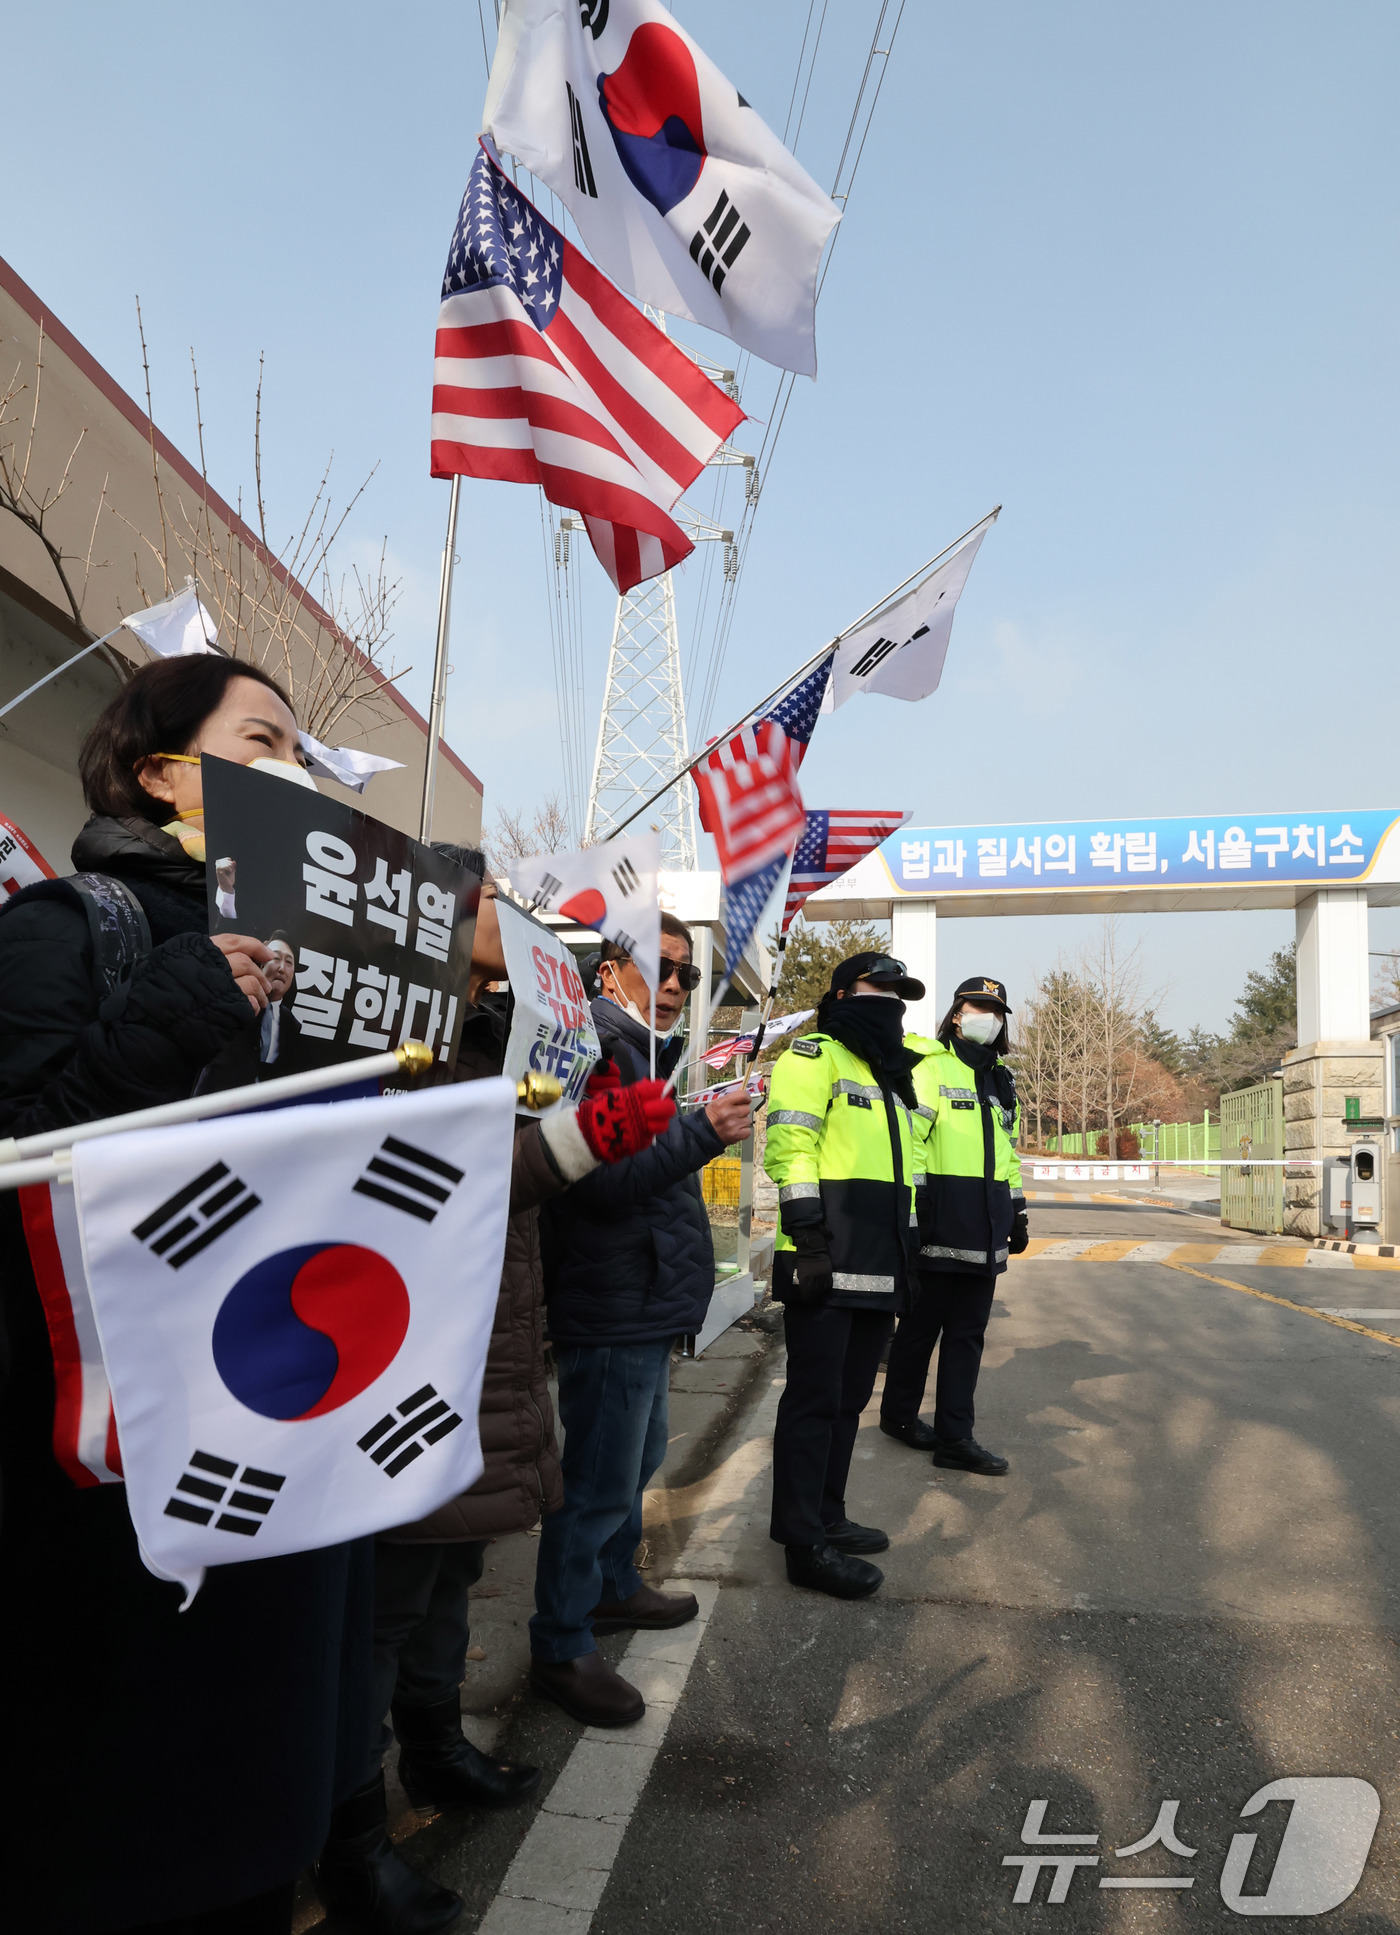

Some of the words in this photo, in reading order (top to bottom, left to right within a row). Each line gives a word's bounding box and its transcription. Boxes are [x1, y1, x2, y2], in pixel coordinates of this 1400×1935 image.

[303, 830, 456, 963] 윤석열
[901, 839, 967, 880] 법과
[977, 833, 1076, 878] 질서의
[1089, 831, 1169, 874] 확립,
[1181, 824, 1365, 870] 서울구치소
[291, 946, 458, 1063] 잘한다!
[531, 945, 584, 1013] STOP
